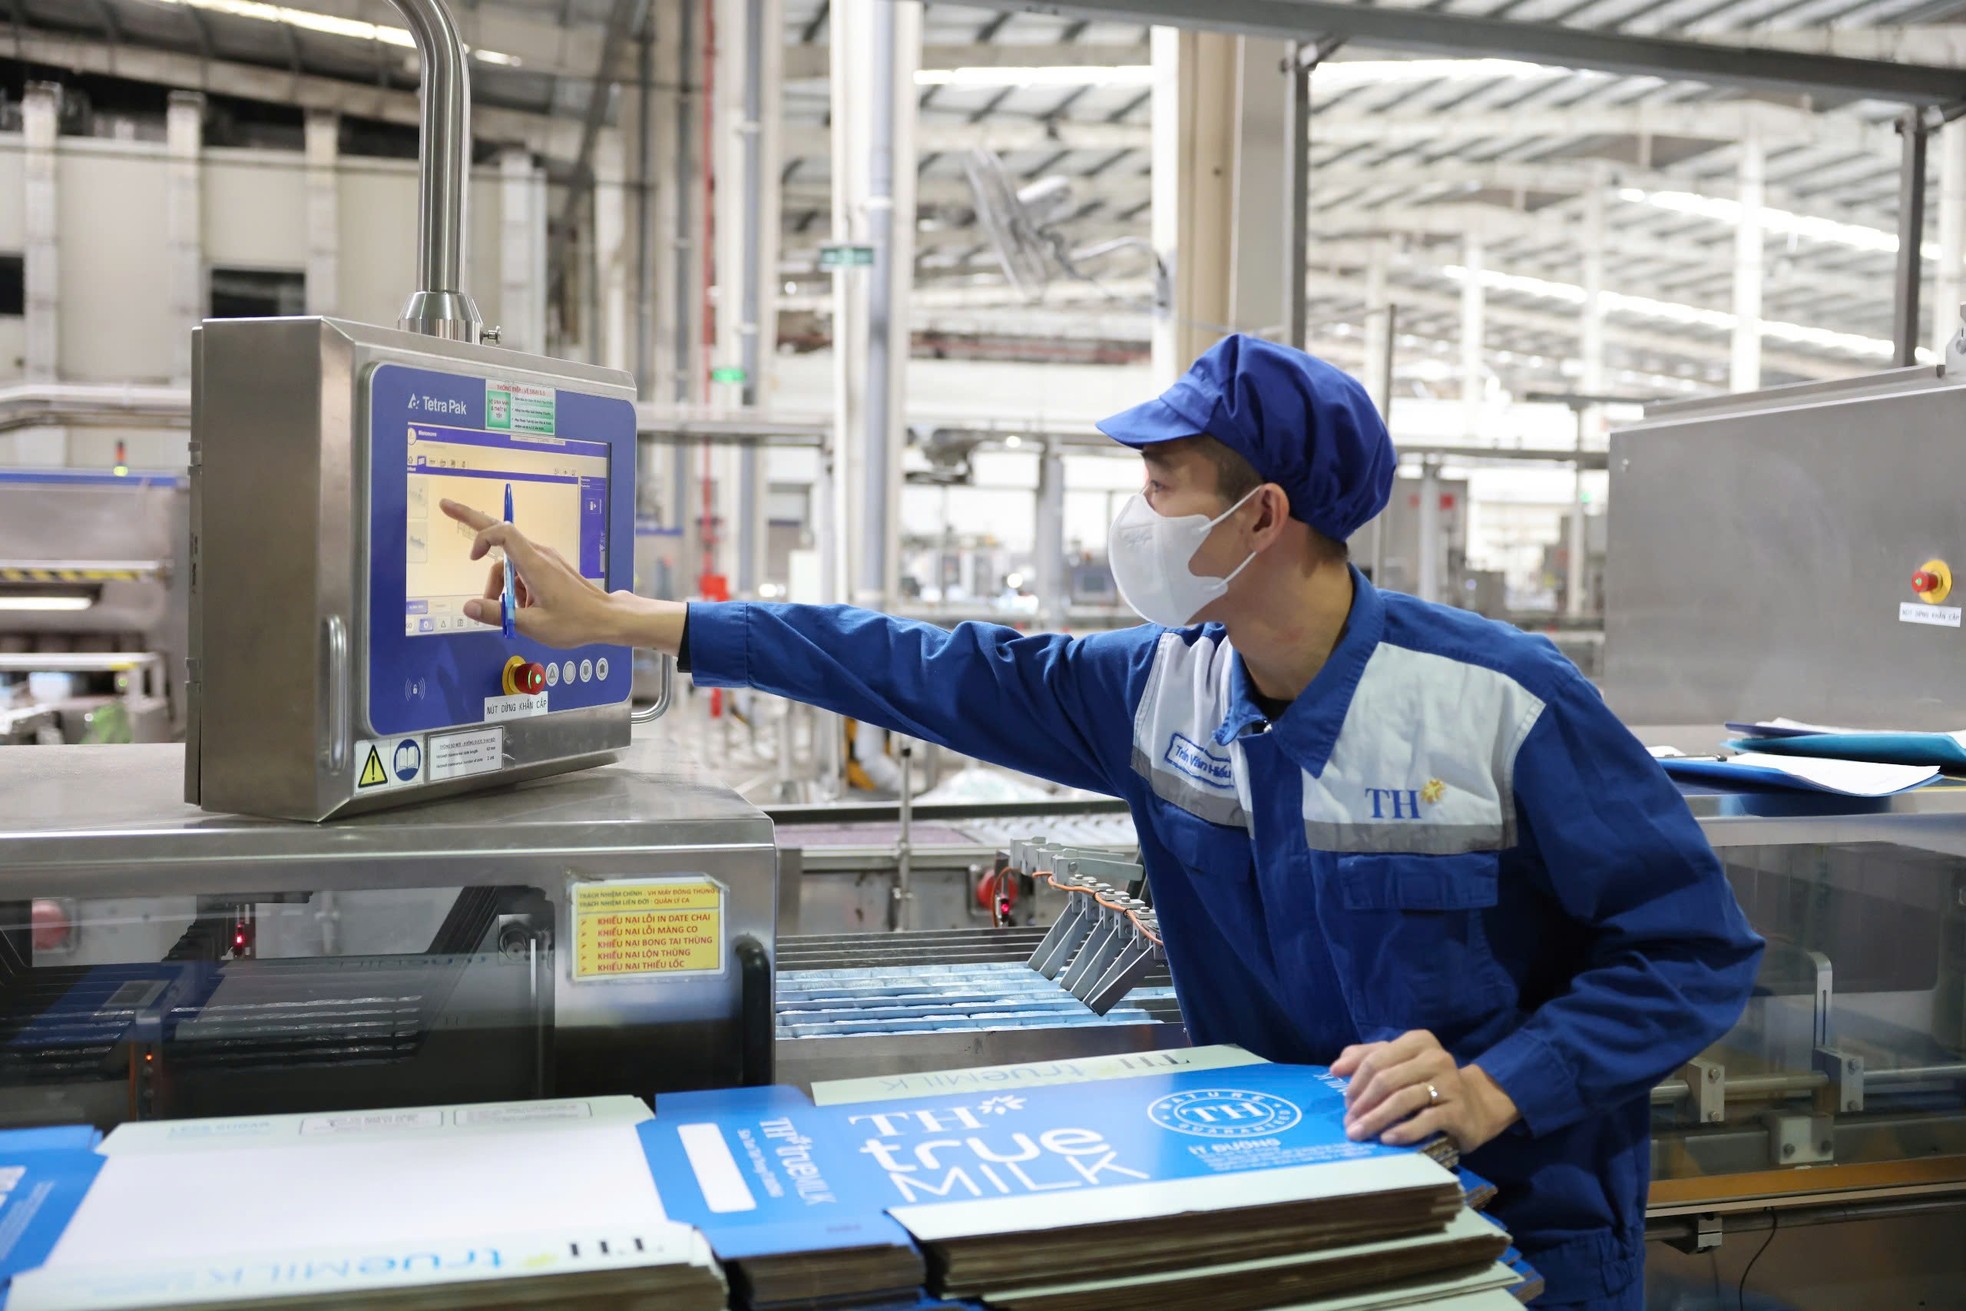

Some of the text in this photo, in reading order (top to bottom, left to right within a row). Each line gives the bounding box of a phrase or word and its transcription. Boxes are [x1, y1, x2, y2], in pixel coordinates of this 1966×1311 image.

[422, 395, 447, 413] Tetra
[448, 399, 467, 415] Pak
[486, 704, 498, 715] NÚT
[1364, 788, 1422, 819] TH
[597, 915, 623, 925] KHIẾU
[657, 915, 667, 923] IN
[668, 914, 689, 923] DATE
[691, 913, 711, 921] CHAI
[597, 927, 623, 937] KHIẾU
[686, 925, 698, 933] CO
[597, 939, 623, 949] KHIẾU
[597, 950, 623, 960] KHIẾU
[597, 962, 623, 972] KHIẾU
[642, 959, 667, 970] THIẾU
[1180, 1102, 1270, 1123] TH
[848, 1106, 990, 1138] TH
[859, 1128, 1111, 1173] true
[888, 1151, 1151, 1203] MILK
